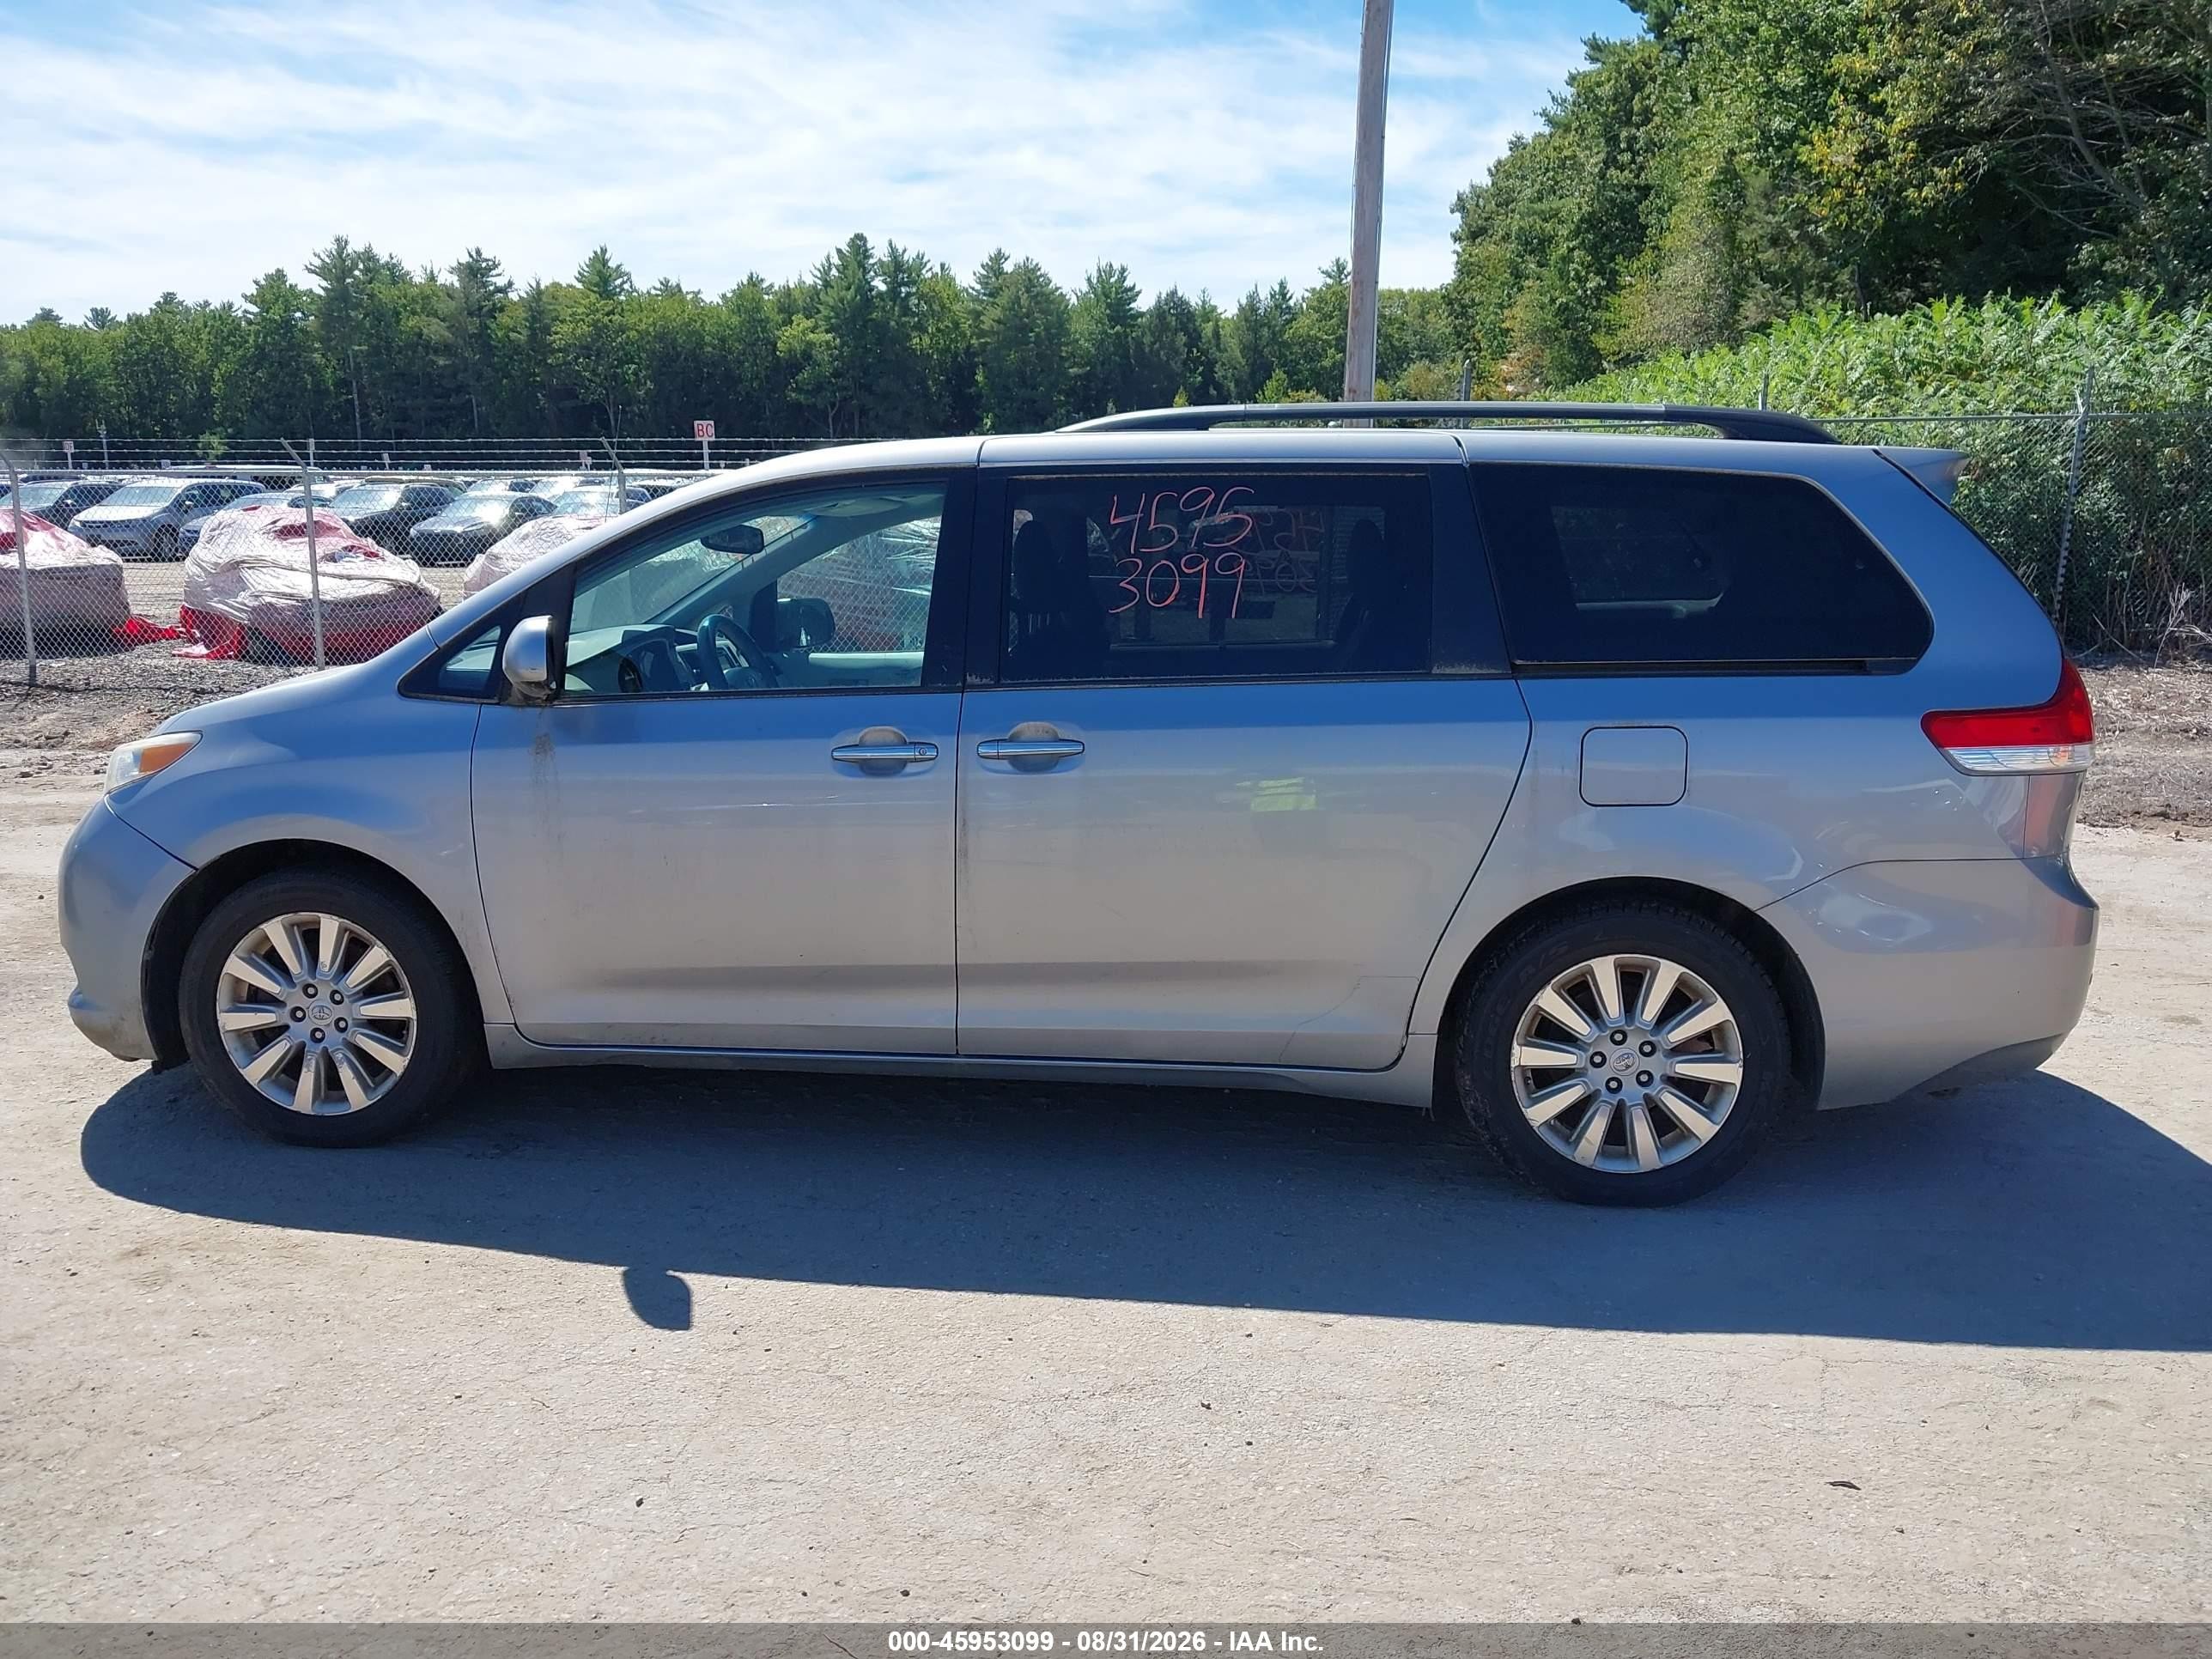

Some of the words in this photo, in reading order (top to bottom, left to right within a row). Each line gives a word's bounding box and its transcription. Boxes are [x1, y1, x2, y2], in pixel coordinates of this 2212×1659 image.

[696, 422, 714, 438] BC
[1109, 486, 1255, 554] 4595
[1108, 552, 1246, 619] 3099
